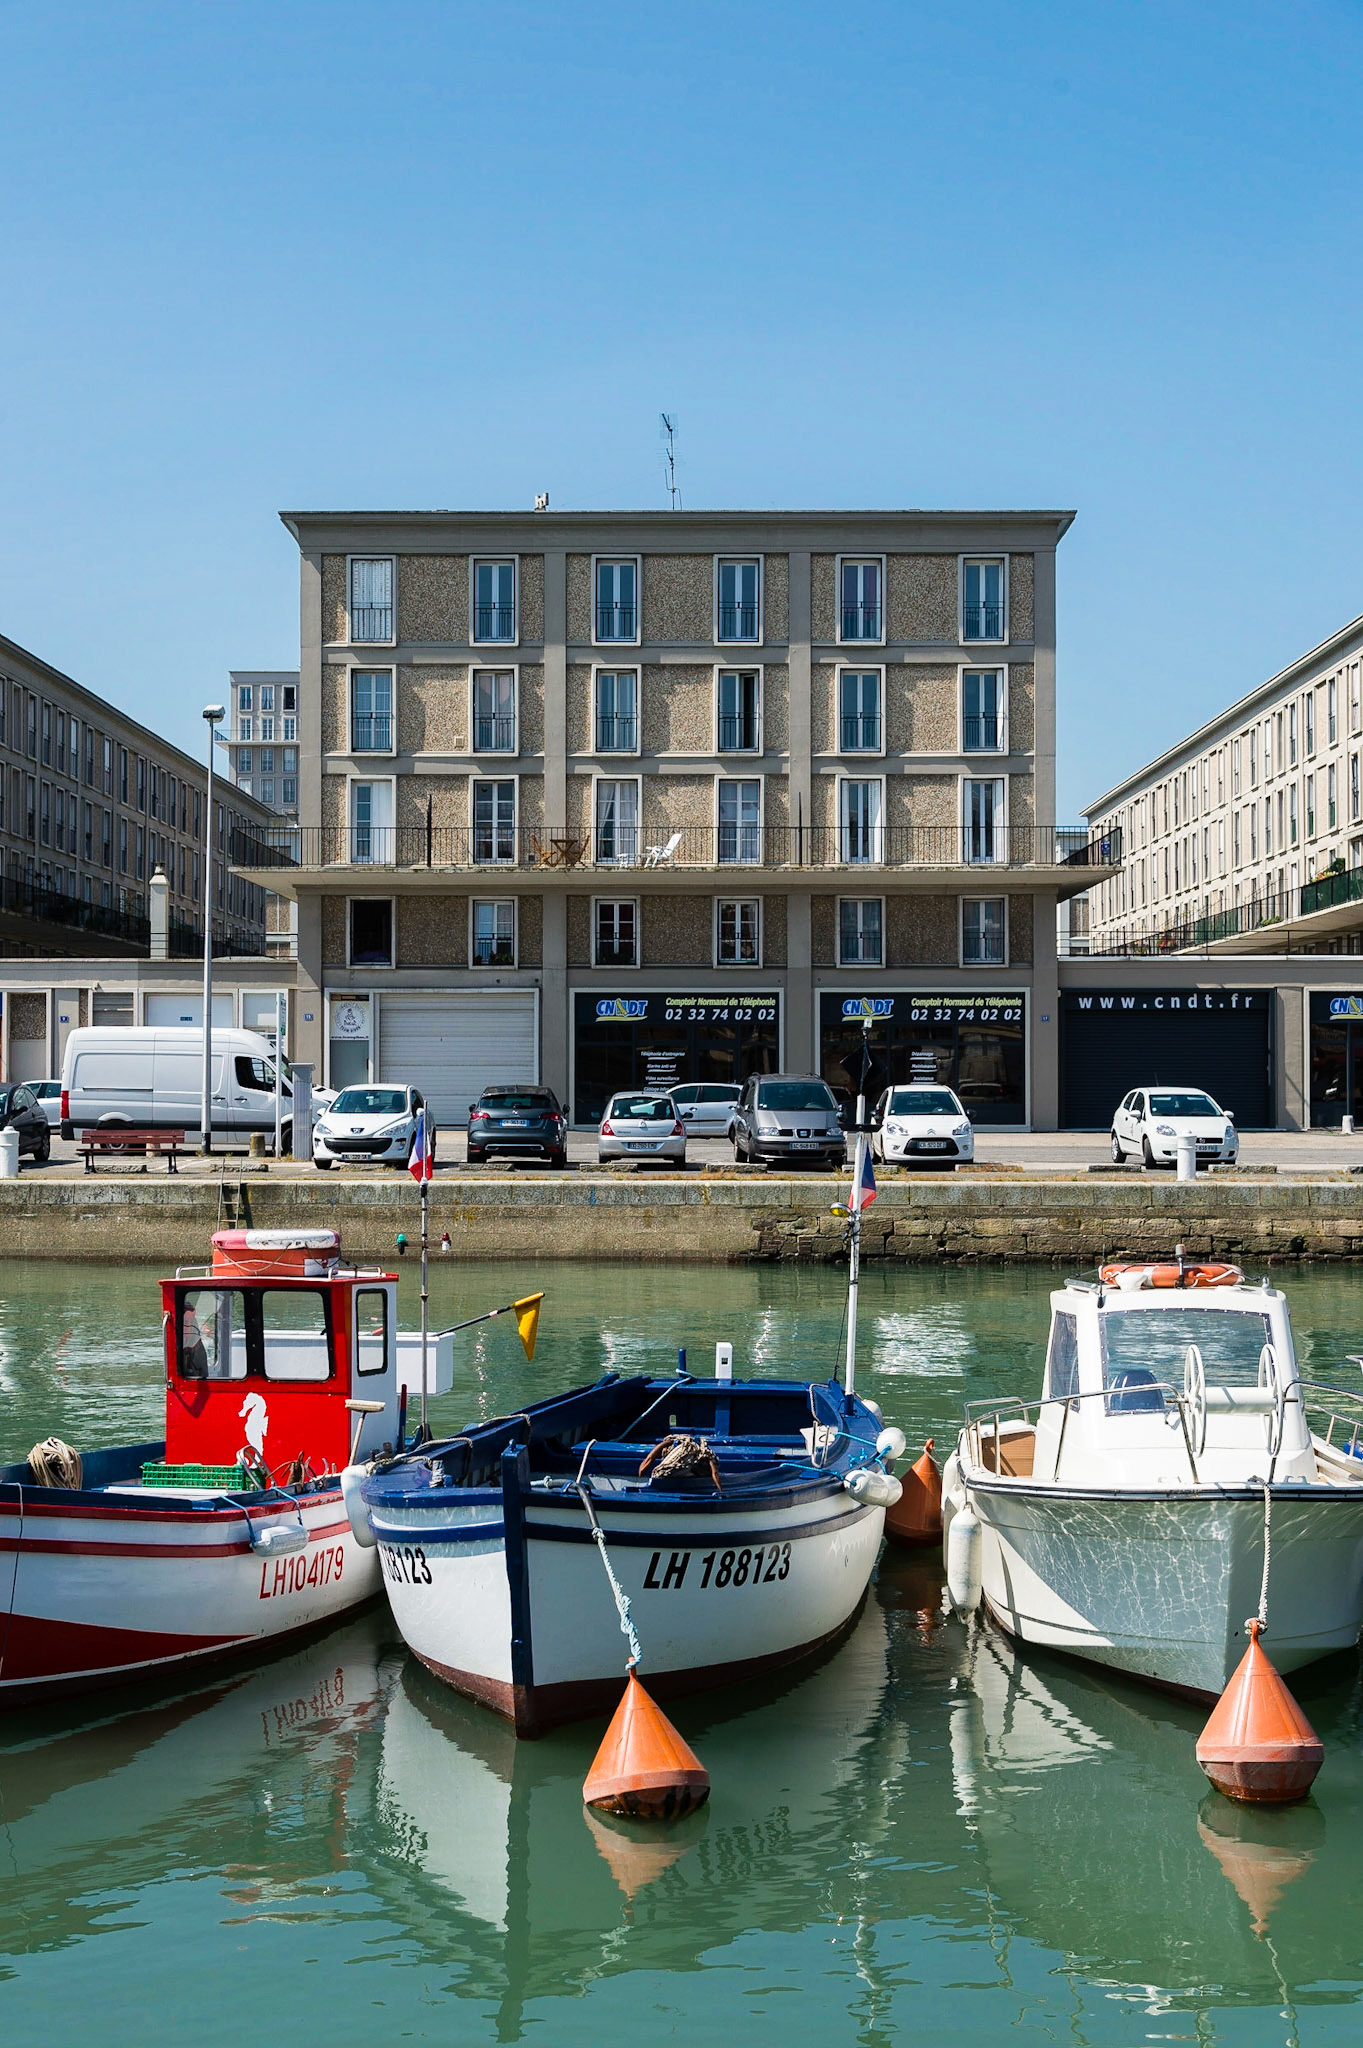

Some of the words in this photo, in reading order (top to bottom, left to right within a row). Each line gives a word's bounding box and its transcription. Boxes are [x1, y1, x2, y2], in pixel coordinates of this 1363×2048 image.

[665, 997, 697, 1007] Comptoir
[697, 997, 728, 1006] Normand
[729, 997, 739, 1006] de
[739, 996, 776, 1008] Téléphonie
[911, 997, 943, 1007] Comptoir
[943, 997, 974, 1006] Normand
[975, 997, 984, 1006] de
[985, 996, 1022, 1008] Téléphonie
[1078, 993, 1253, 1009] www.cndt.fr
[665, 1009, 682, 1020] 02
[688, 1009, 705, 1020] 32
[712, 1009, 729, 1020] 74
[735, 1009, 751, 1020] 02
[758, 1009, 775, 1020] 02
[911, 1009, 928, 1020] 02
[934, 1009, 951, 1020] 32
[958, 1009, 974, 1020] 74
[981, 1009, 997, 1020] 02
[1004, 1009, 1021, 1020] 02
[643, 1552, 691, 1589] LH
[700, 1542, 791, 1589] 188123
[259, 1546, 344, 1600] LH104179
